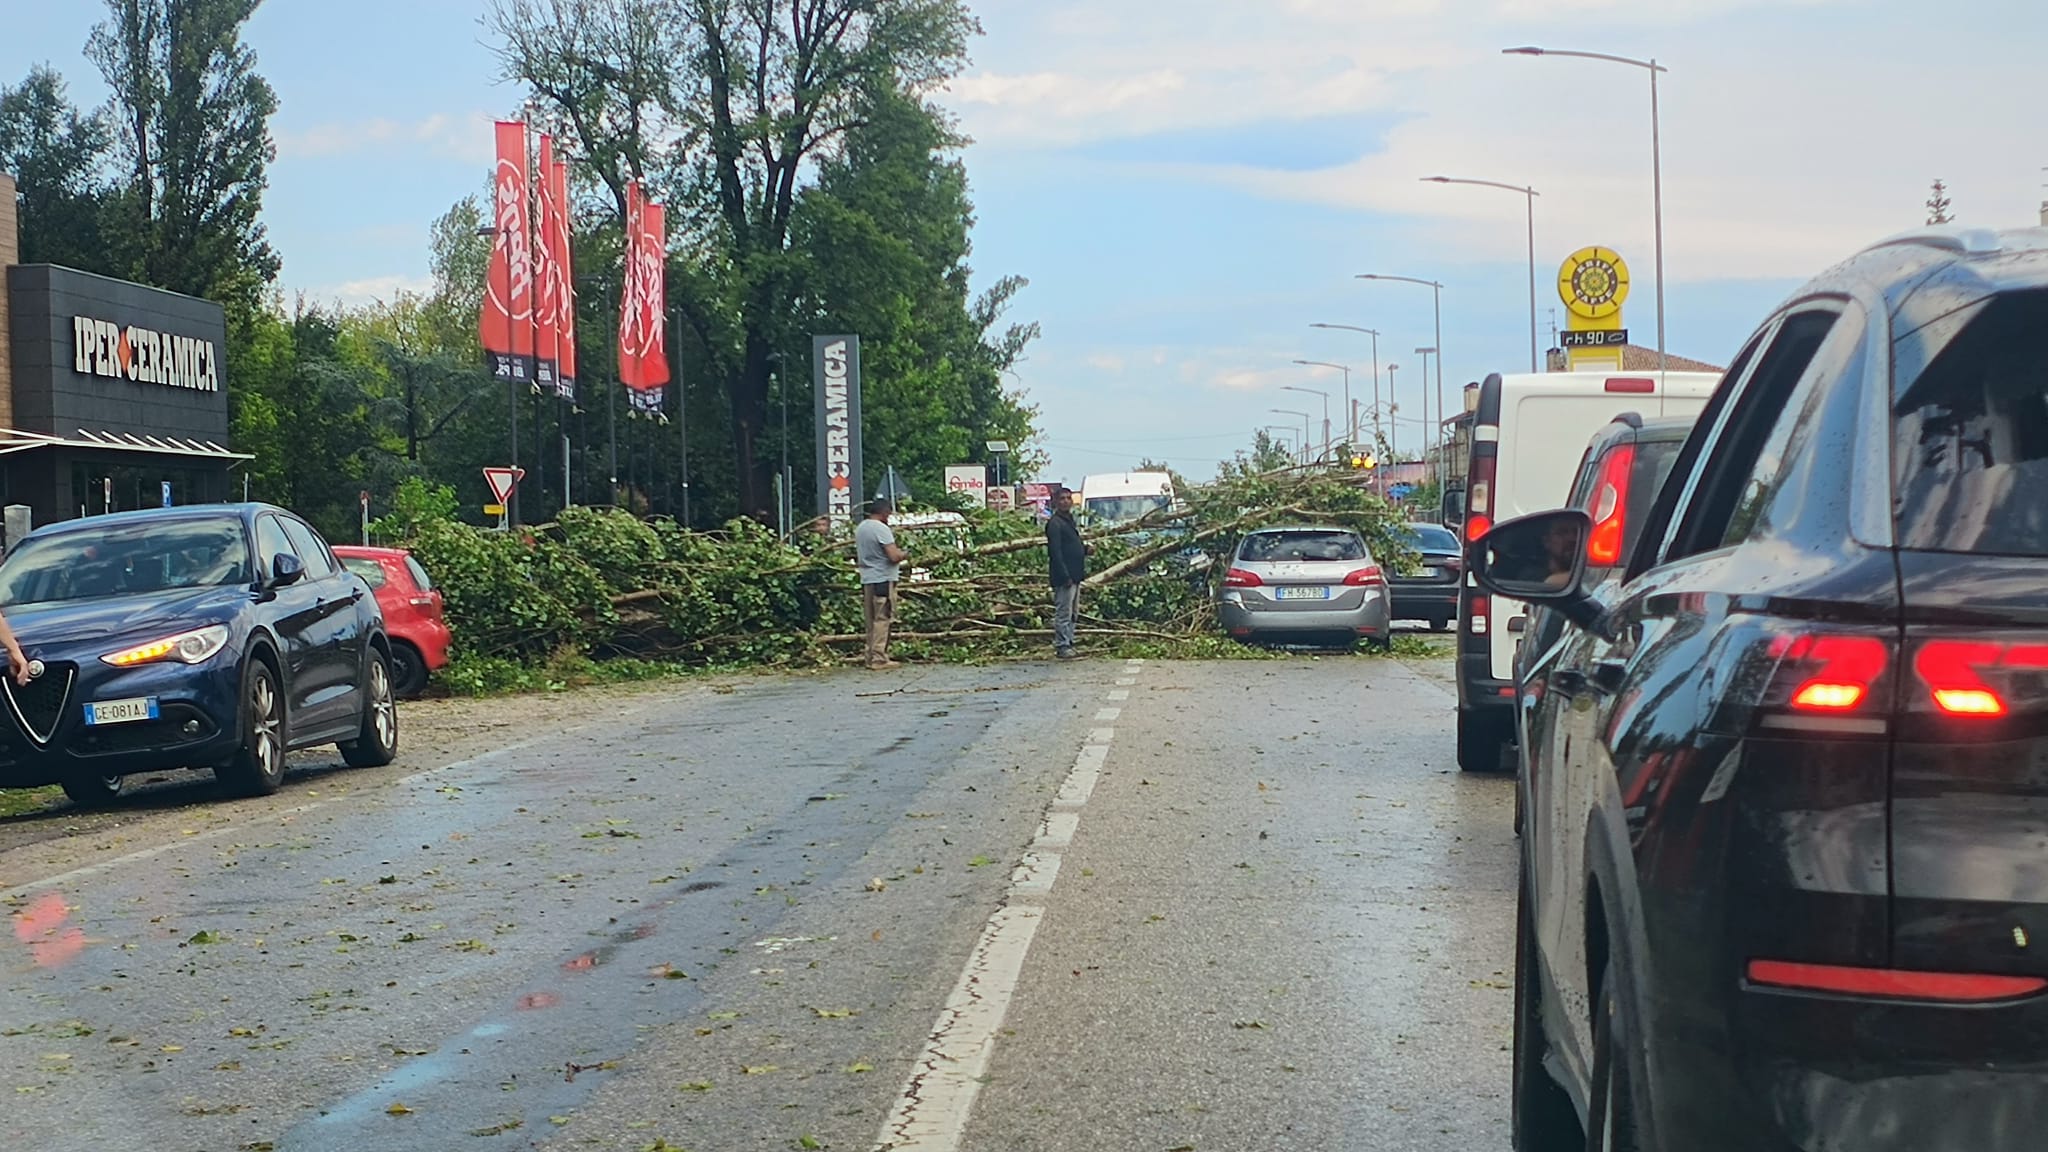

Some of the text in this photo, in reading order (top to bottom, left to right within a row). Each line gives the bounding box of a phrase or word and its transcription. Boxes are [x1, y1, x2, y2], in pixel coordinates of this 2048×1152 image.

[1577, 259, 1613, 274] KRIFI
[1586, 331, 1604, 345] 90
[74, 315, 218, 392] IPER CERAMICA
[824, 340, 851, 479] CERAMICA
[949, 475, 983, 491] famila
